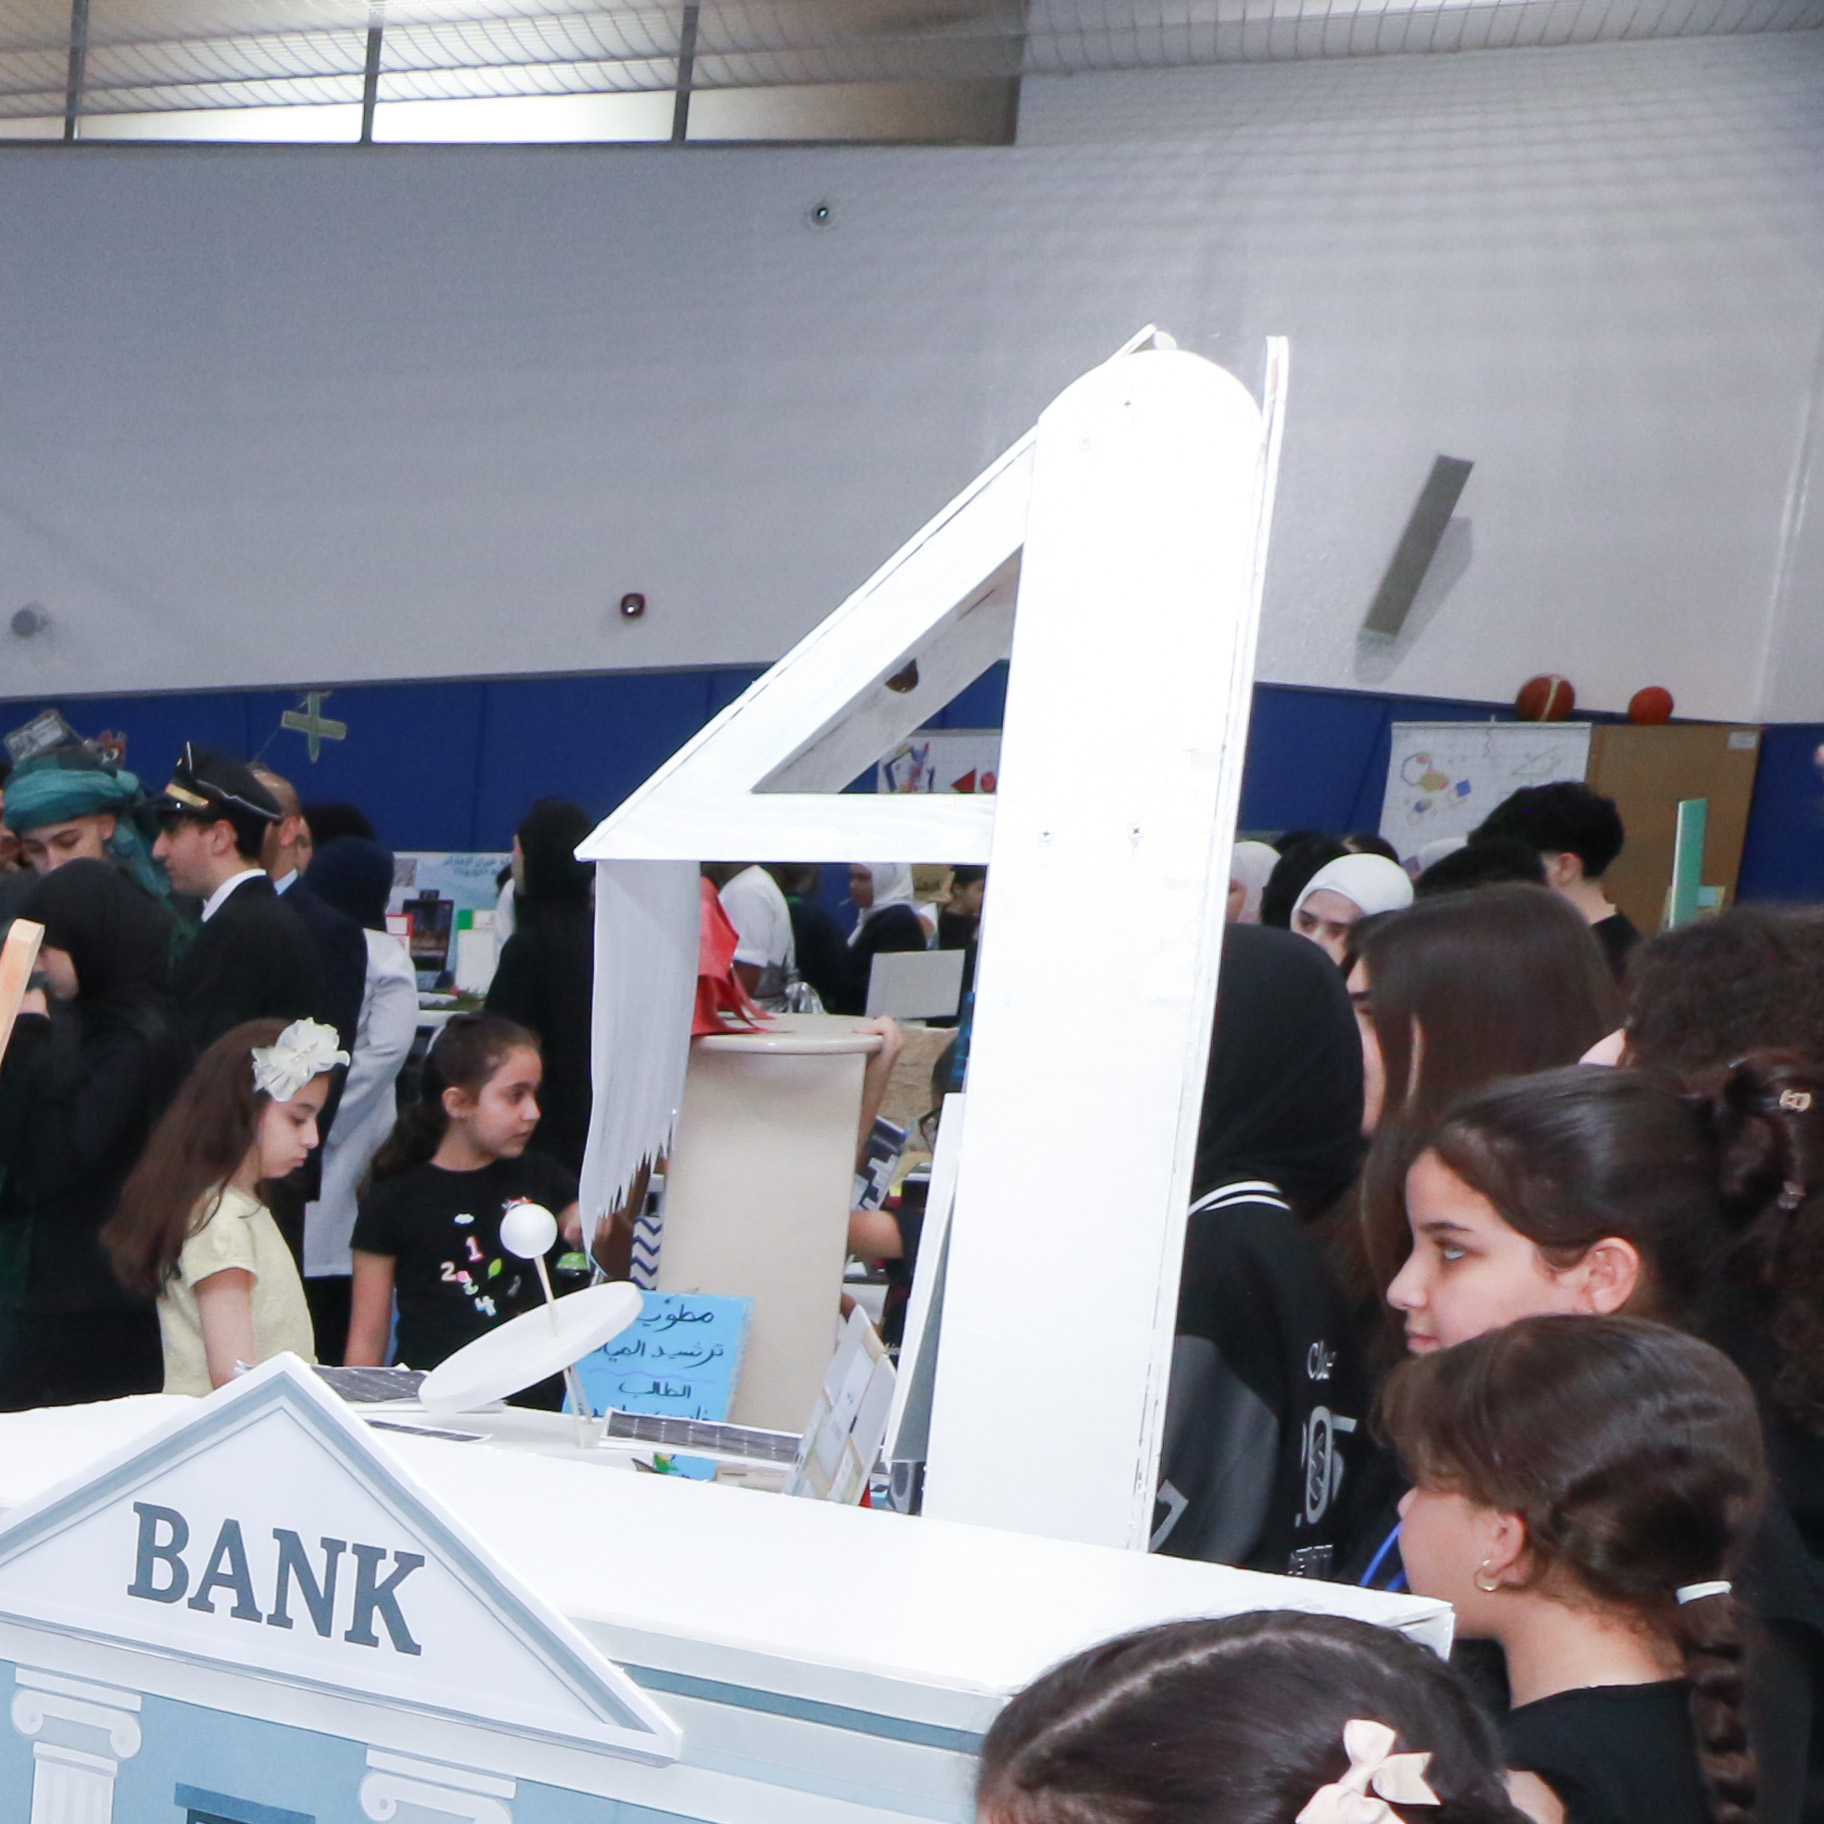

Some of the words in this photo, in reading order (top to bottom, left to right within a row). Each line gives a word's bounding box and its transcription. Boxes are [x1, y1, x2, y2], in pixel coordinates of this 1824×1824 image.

[465, 1235, 485, 1262] 1
[440, 1261, 457, 1283] 2
[474, 1296, 497, 1317] 4
[618, 1380, 692, 1399] الطالب
[127, 1501, 426, 1657] BANK
